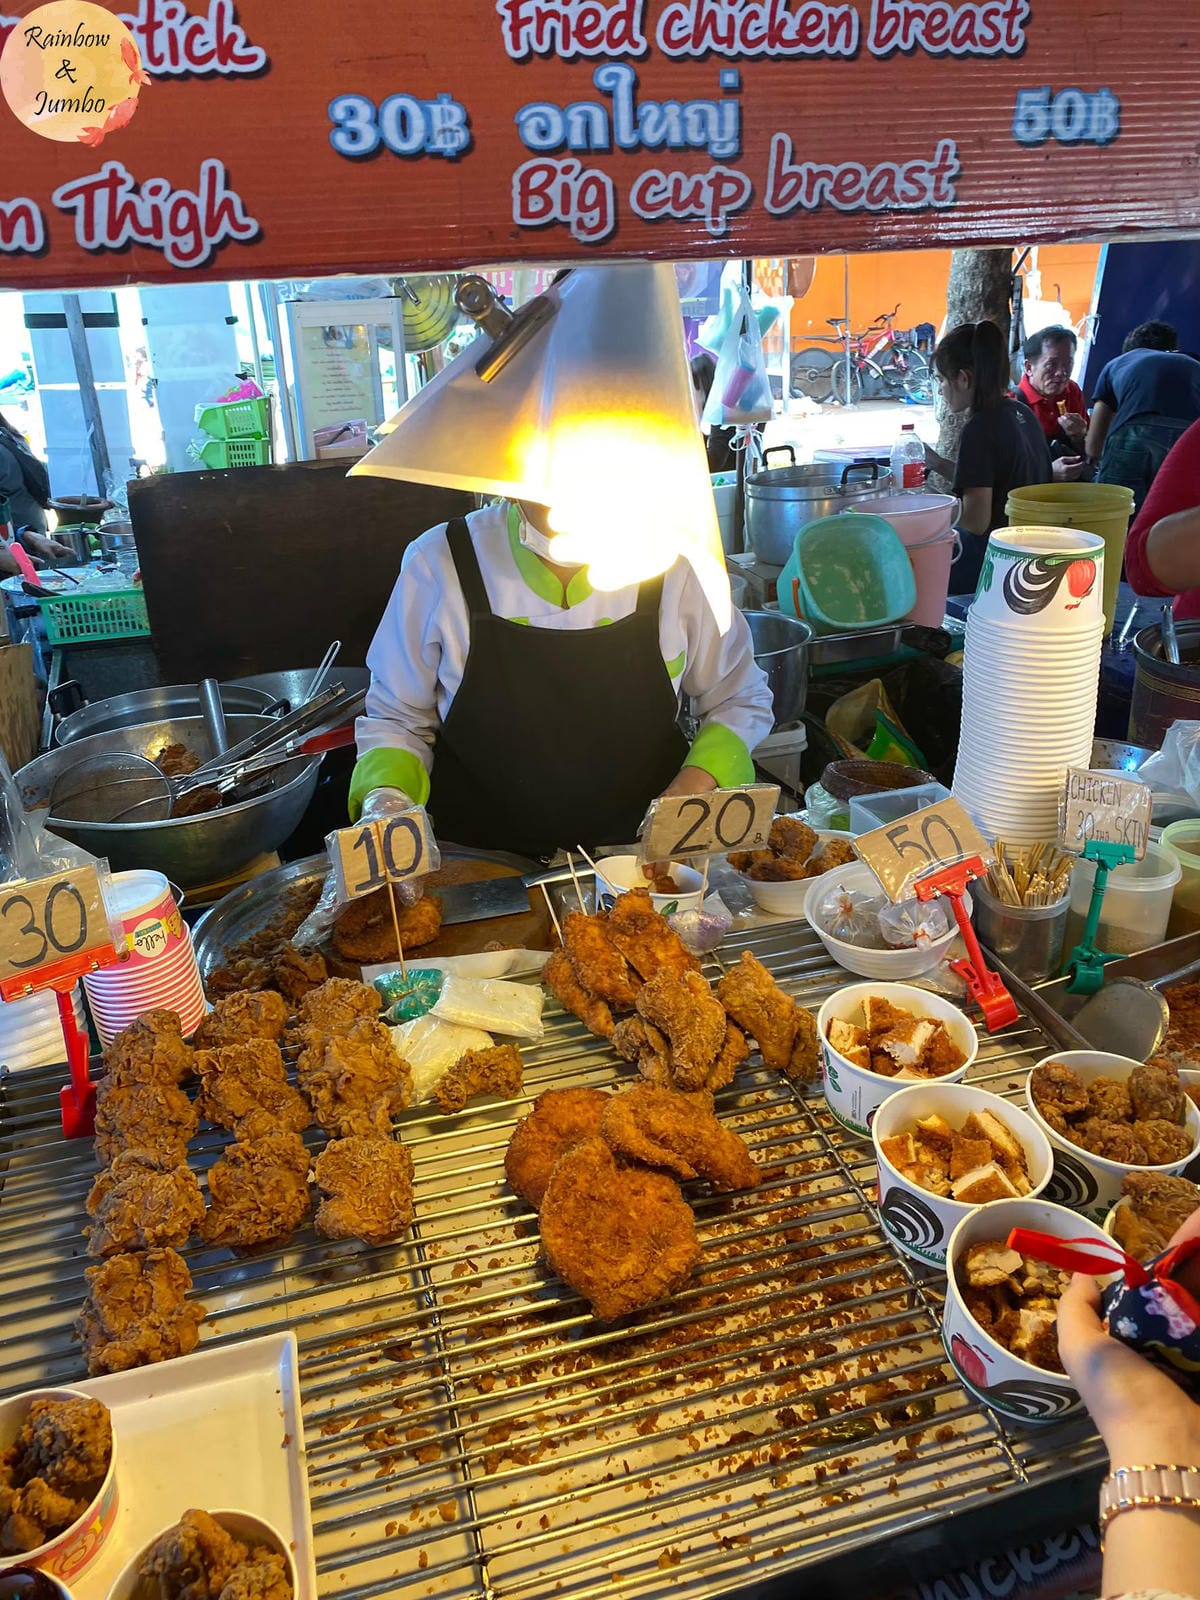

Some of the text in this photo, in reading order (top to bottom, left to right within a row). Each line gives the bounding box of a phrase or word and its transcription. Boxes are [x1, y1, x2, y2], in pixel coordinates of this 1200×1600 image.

[497, 0, 1028, 57] Fried chicken breast
[515, 62, 739, 158] อกใหญ่
[52, 159, 259, 268] Thigh
[512, 132, 960, 241] Big cup breast
[1070, 774, 1122, 807] CHICKEN
[352, 816, 424, 892] 10
[885, 814, 964, 879] 50
[1, 880, 87, 968] 30
[134, 930, 167, 951] hello
